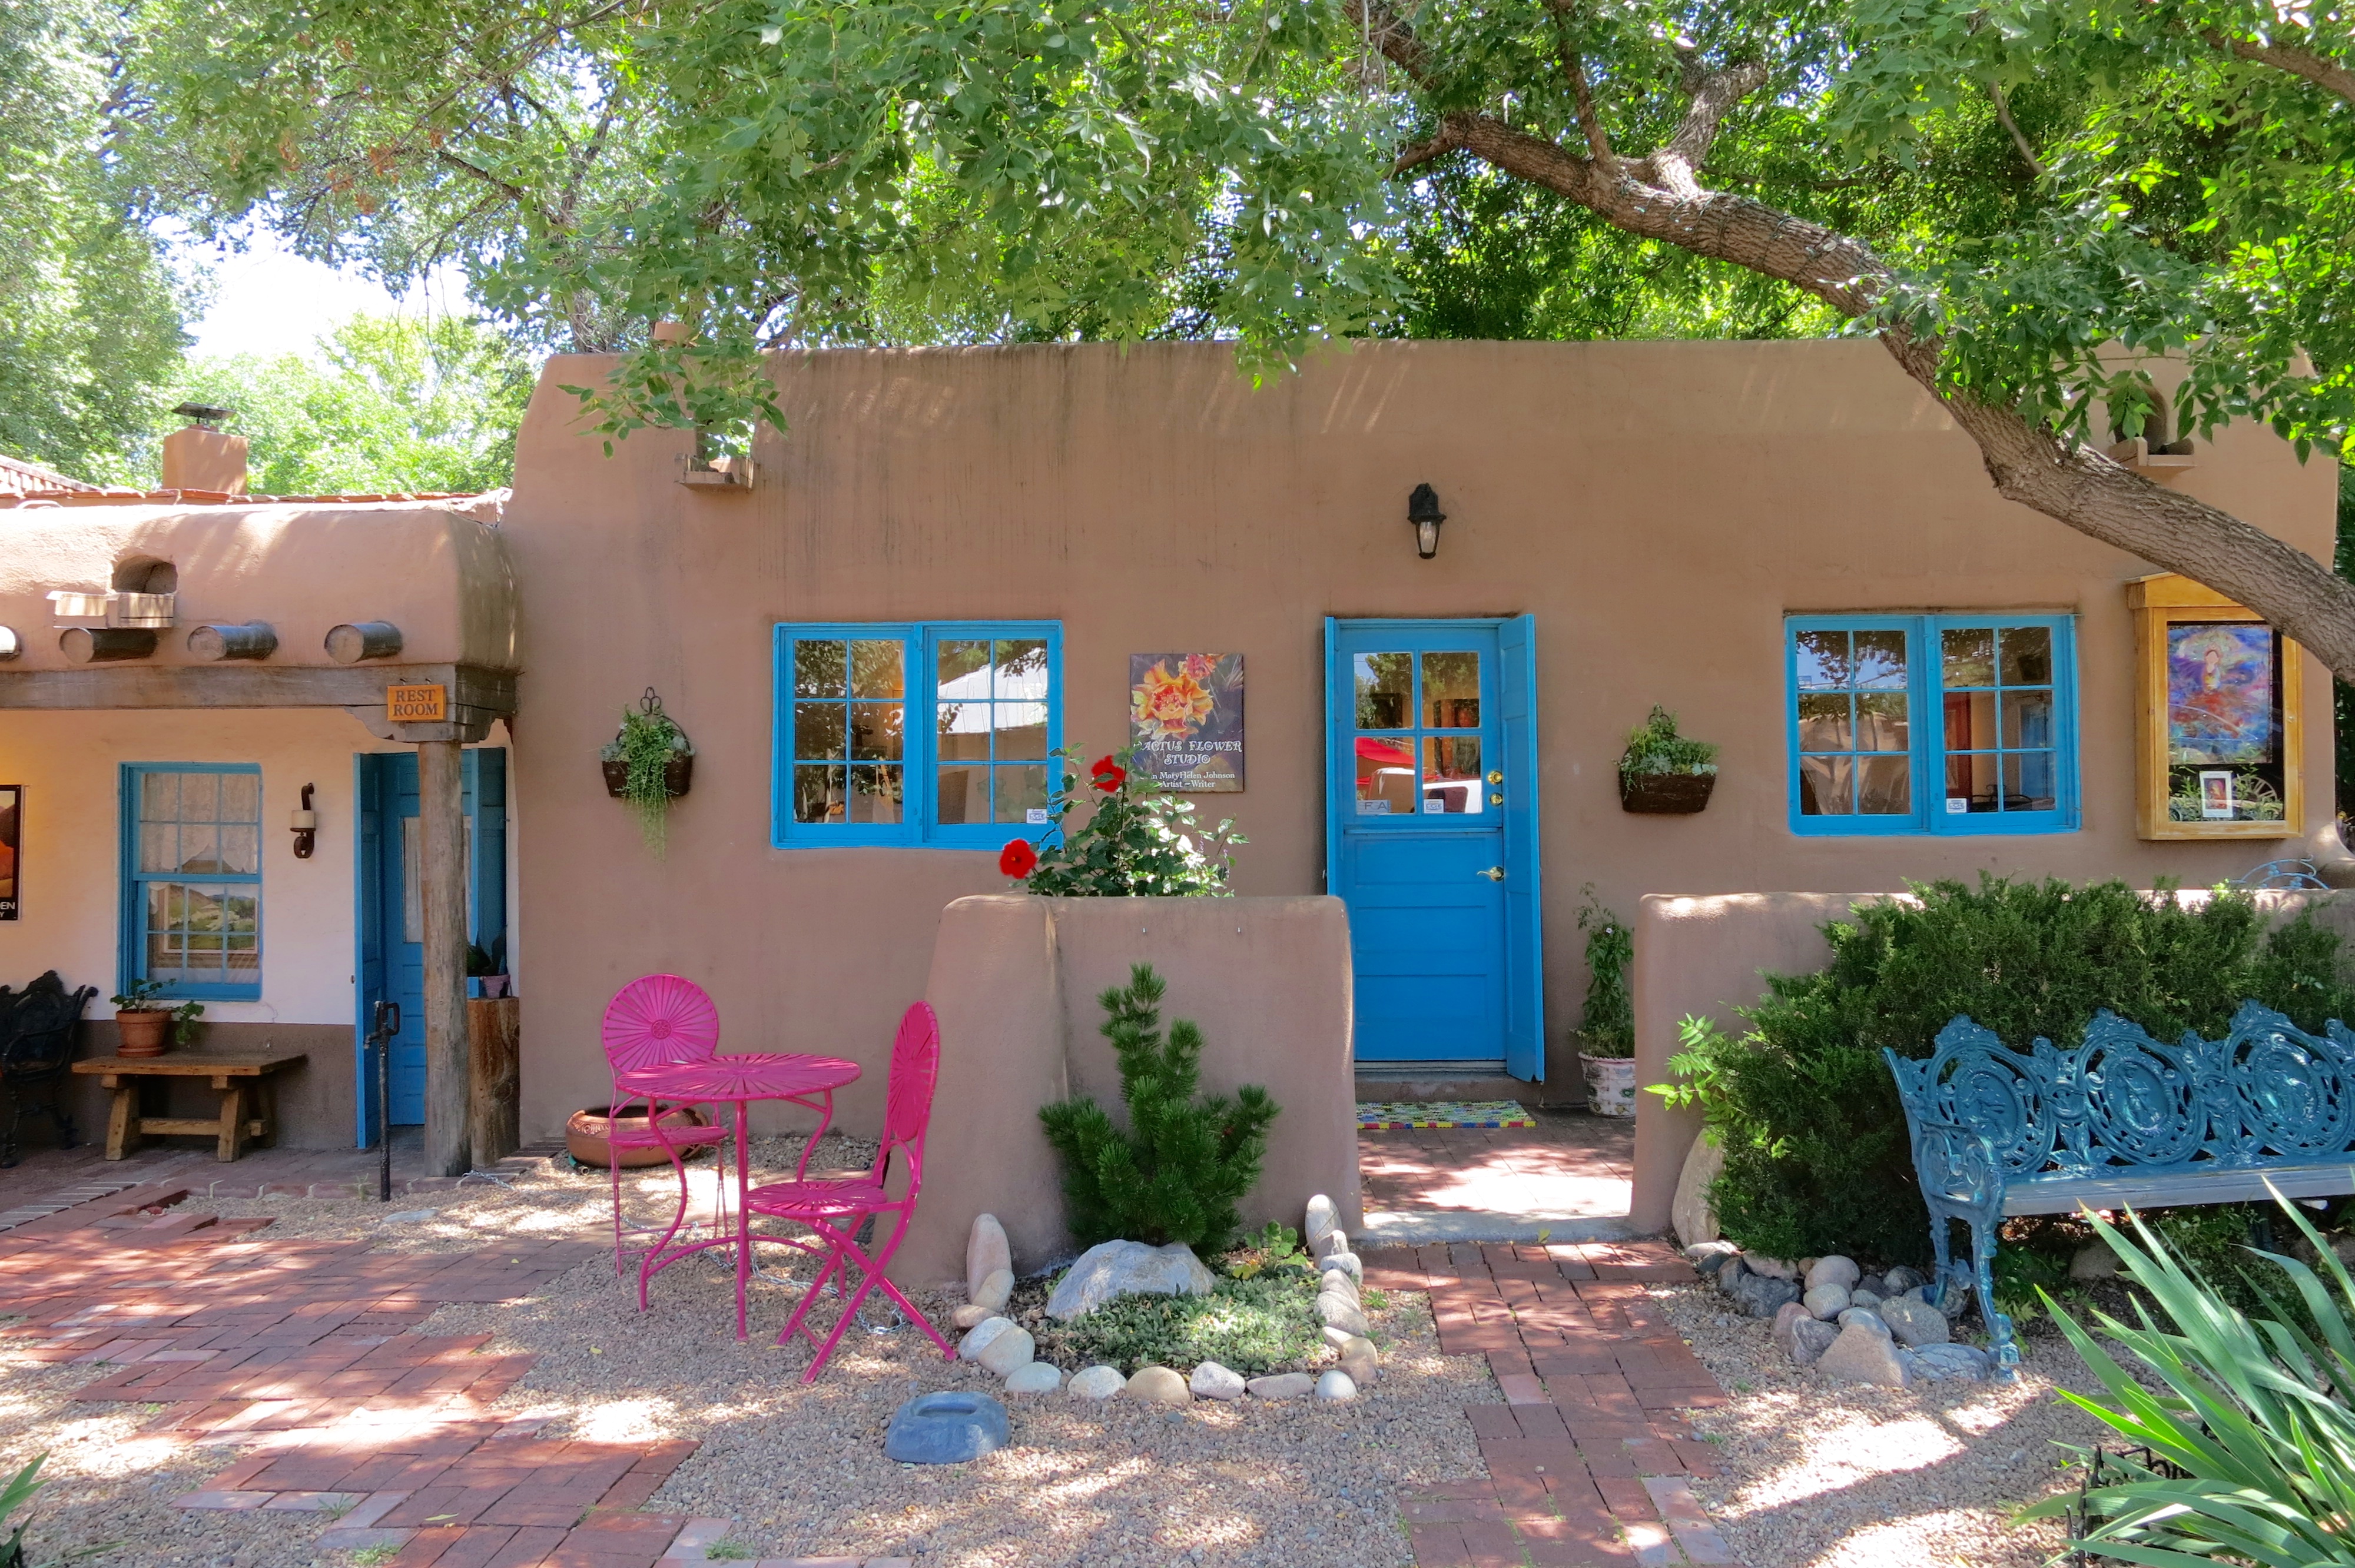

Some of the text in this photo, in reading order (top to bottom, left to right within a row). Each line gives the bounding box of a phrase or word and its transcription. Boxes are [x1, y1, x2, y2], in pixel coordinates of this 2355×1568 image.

[395, 689, 435, 702] REST
[393, 703, 438, 716] ROOM
[1188, 740, 1242, 752] FLOWER
[1164, 753, 1210, 765] STUDIO
